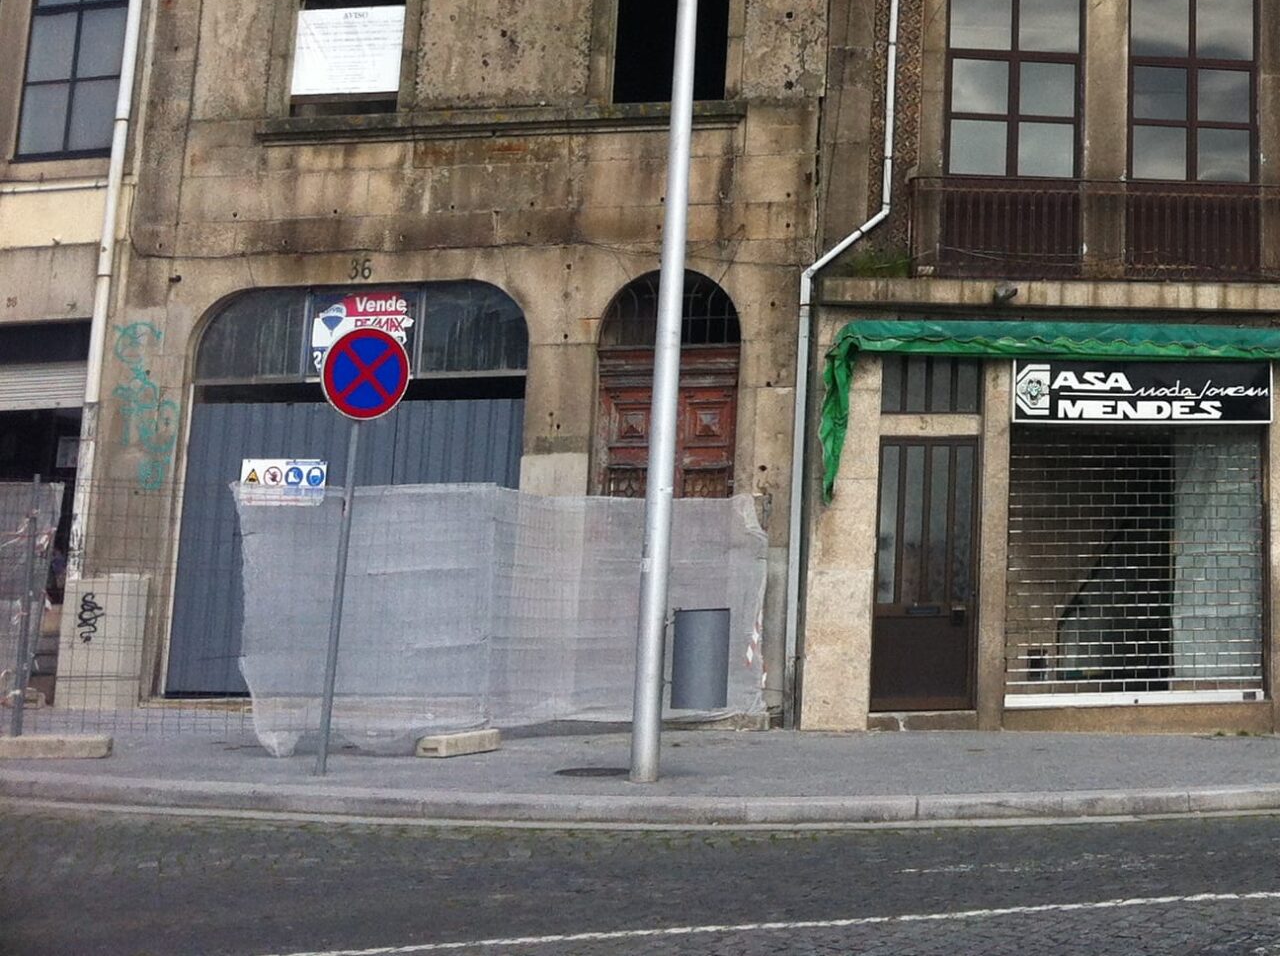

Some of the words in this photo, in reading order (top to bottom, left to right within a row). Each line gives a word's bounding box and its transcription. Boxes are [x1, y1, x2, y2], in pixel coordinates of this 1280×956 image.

[343, 11, 369, 20] AVISO
[348, 258, 372, 280] 36
[355, 296, 407, 312] Vende
[1057, 399, 1223, 419] MENDES
